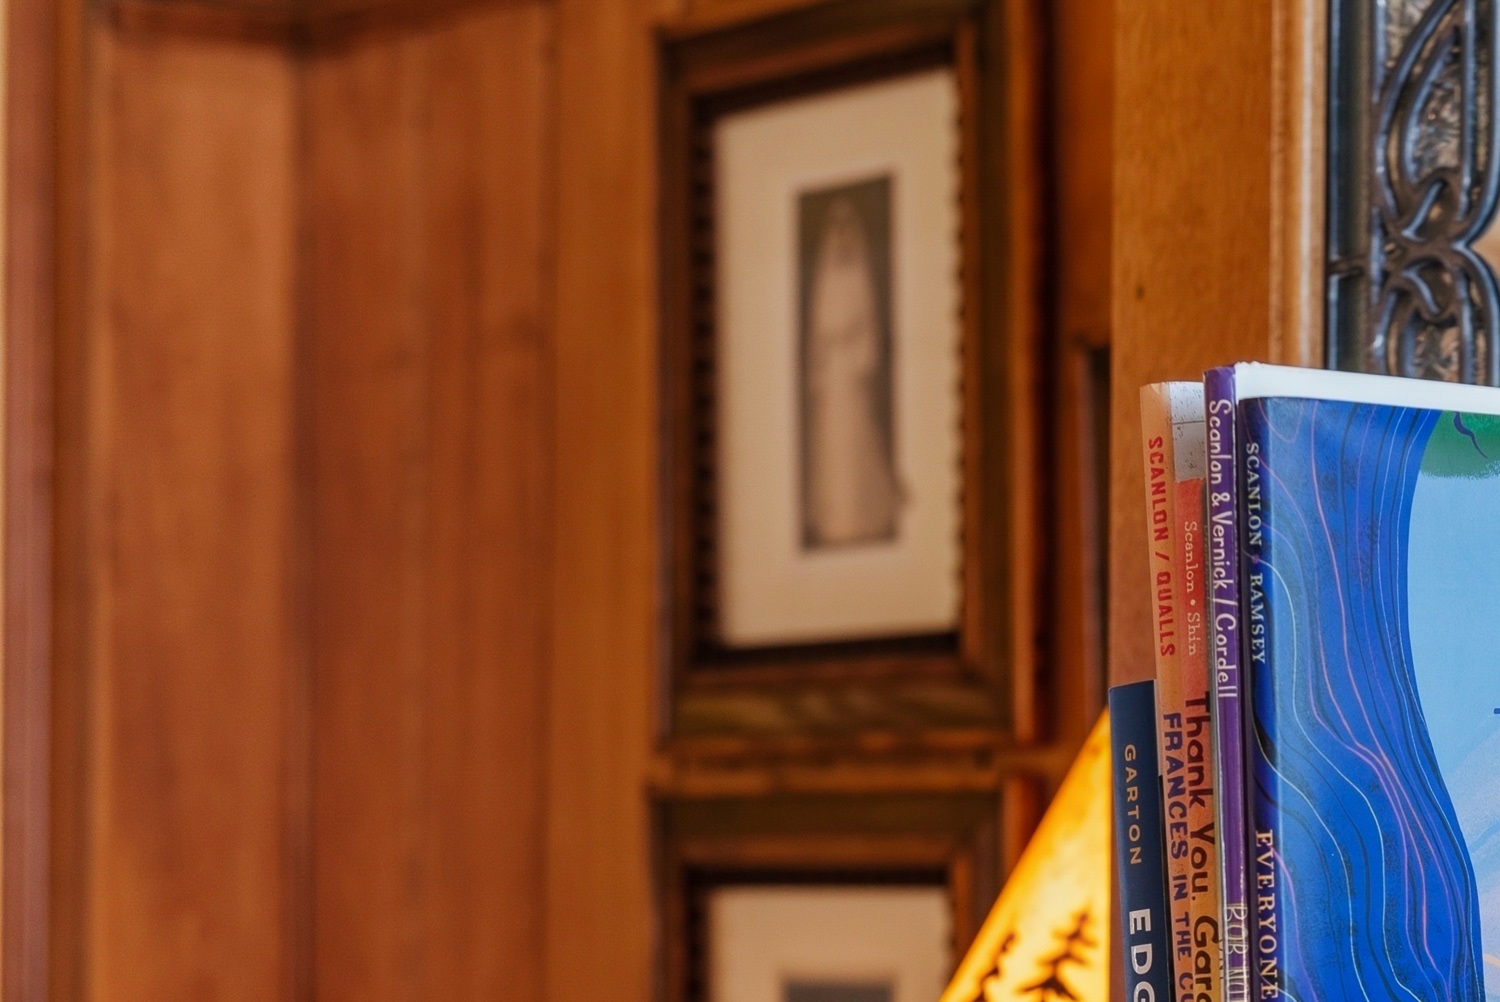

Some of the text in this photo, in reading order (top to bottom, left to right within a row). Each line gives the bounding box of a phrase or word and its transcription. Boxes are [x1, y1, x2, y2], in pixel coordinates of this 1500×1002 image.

[1148, 436, 1168, 542] SCANLON
[1209, 398, 1231, 485] Scanlon
[1212, 492, 1231, 507] &
[1184, 520, 1200, 656] Scanlon Shin
[1212, 511, 1233, 590] Vernick
[1247, 442, 1266, 664] SCANLON RAMSEY
[1156, 571, 1176, 657] QUALLS
[1215, 612, 1238, 699] Cordell
[1162, 712, 1189, 860] FRANCES
[1185, 691, 1214, 809] Thank
[1124, 743, 1142, 865] GARTON
[1172, 874, 1189, 901] IN
[1174, 912, 1192, 958] THE
[1255, 829, 1279, 1001] EVERYONE
